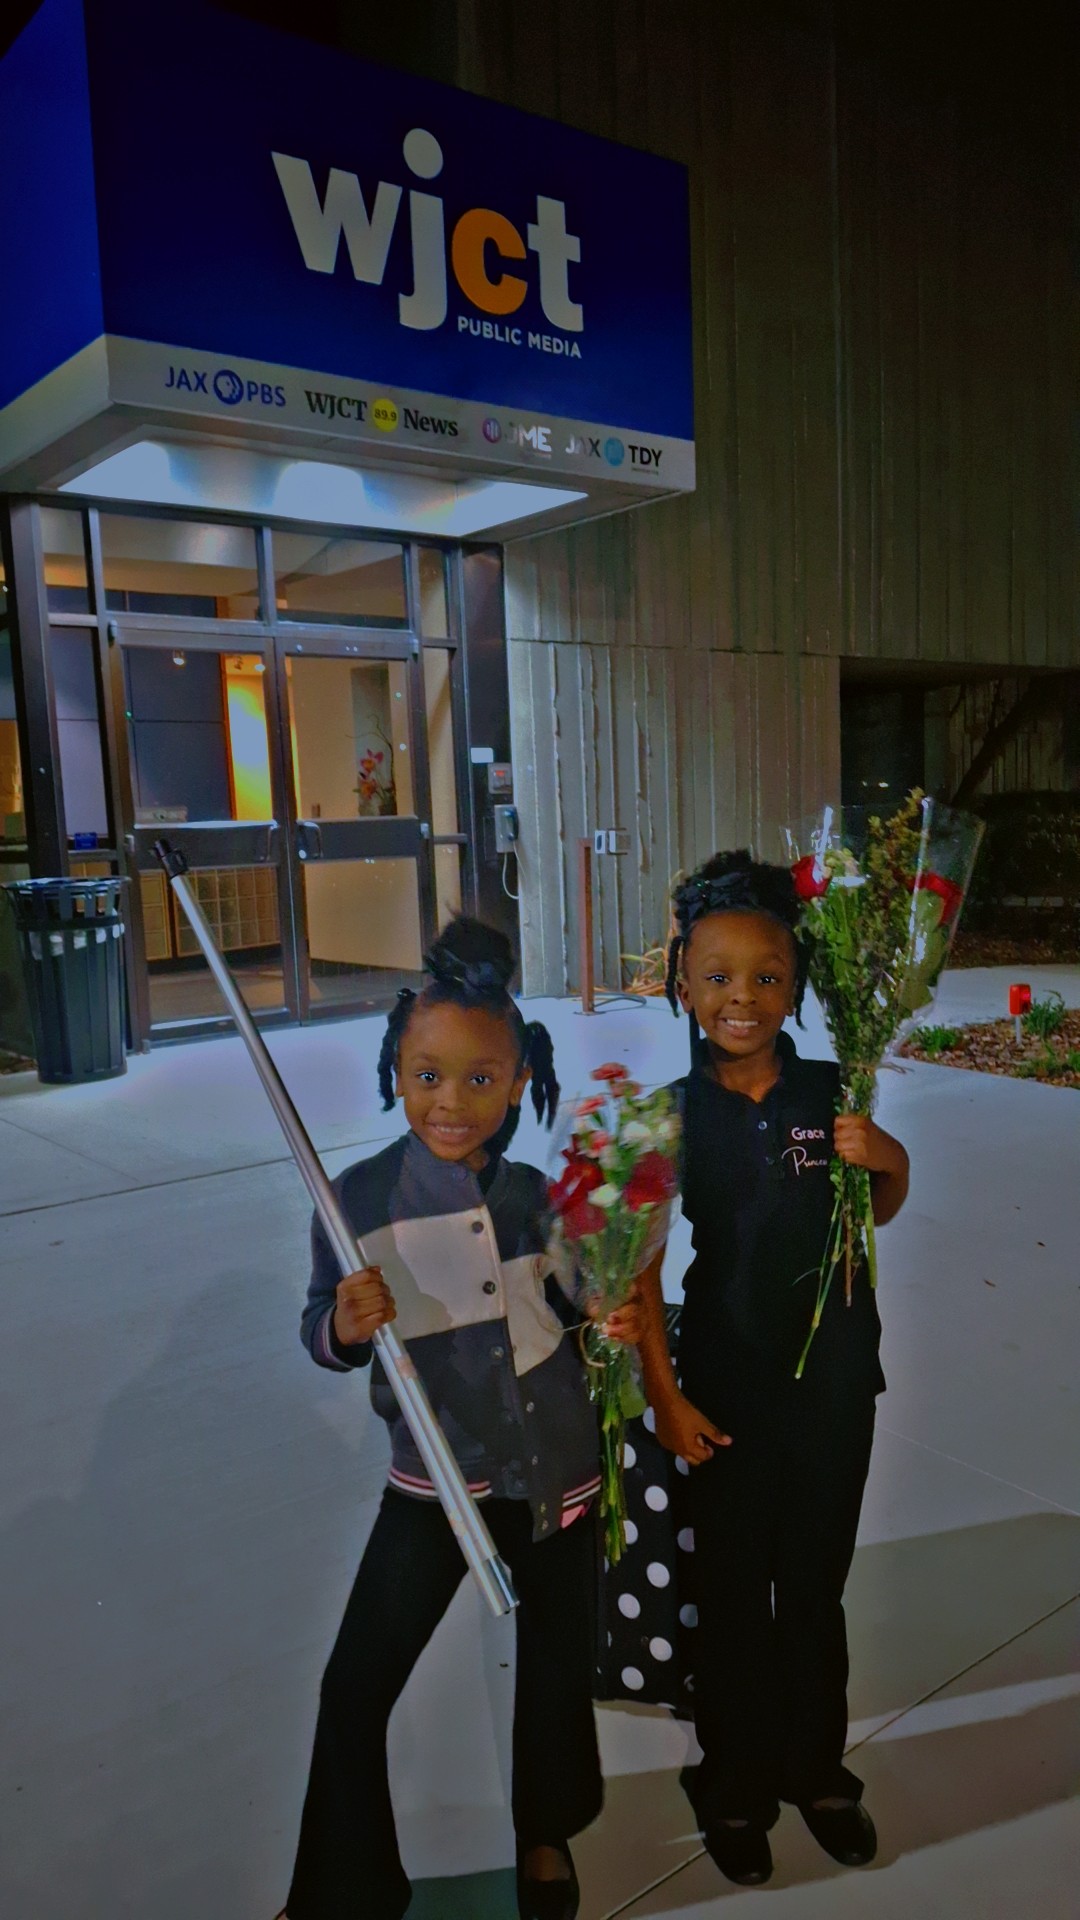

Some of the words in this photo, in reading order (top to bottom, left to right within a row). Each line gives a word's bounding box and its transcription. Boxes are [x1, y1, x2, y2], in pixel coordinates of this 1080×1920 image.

[271, 128, 583, 332] wjct
[457, 315, 522, 345] PUBLIC
[527, 331, 582, 359] MEDIA
[165, 366, 208, 394] JAX
[246, 380, 286, 407] PBS
[304, 390, 367, 422] WJCT
[374, 408, 397, 422] 89.9
[403, 408, 459, 437] News
[628, 445, 662, 467] TDY
[791, 1127, 826, 1141] Grace
